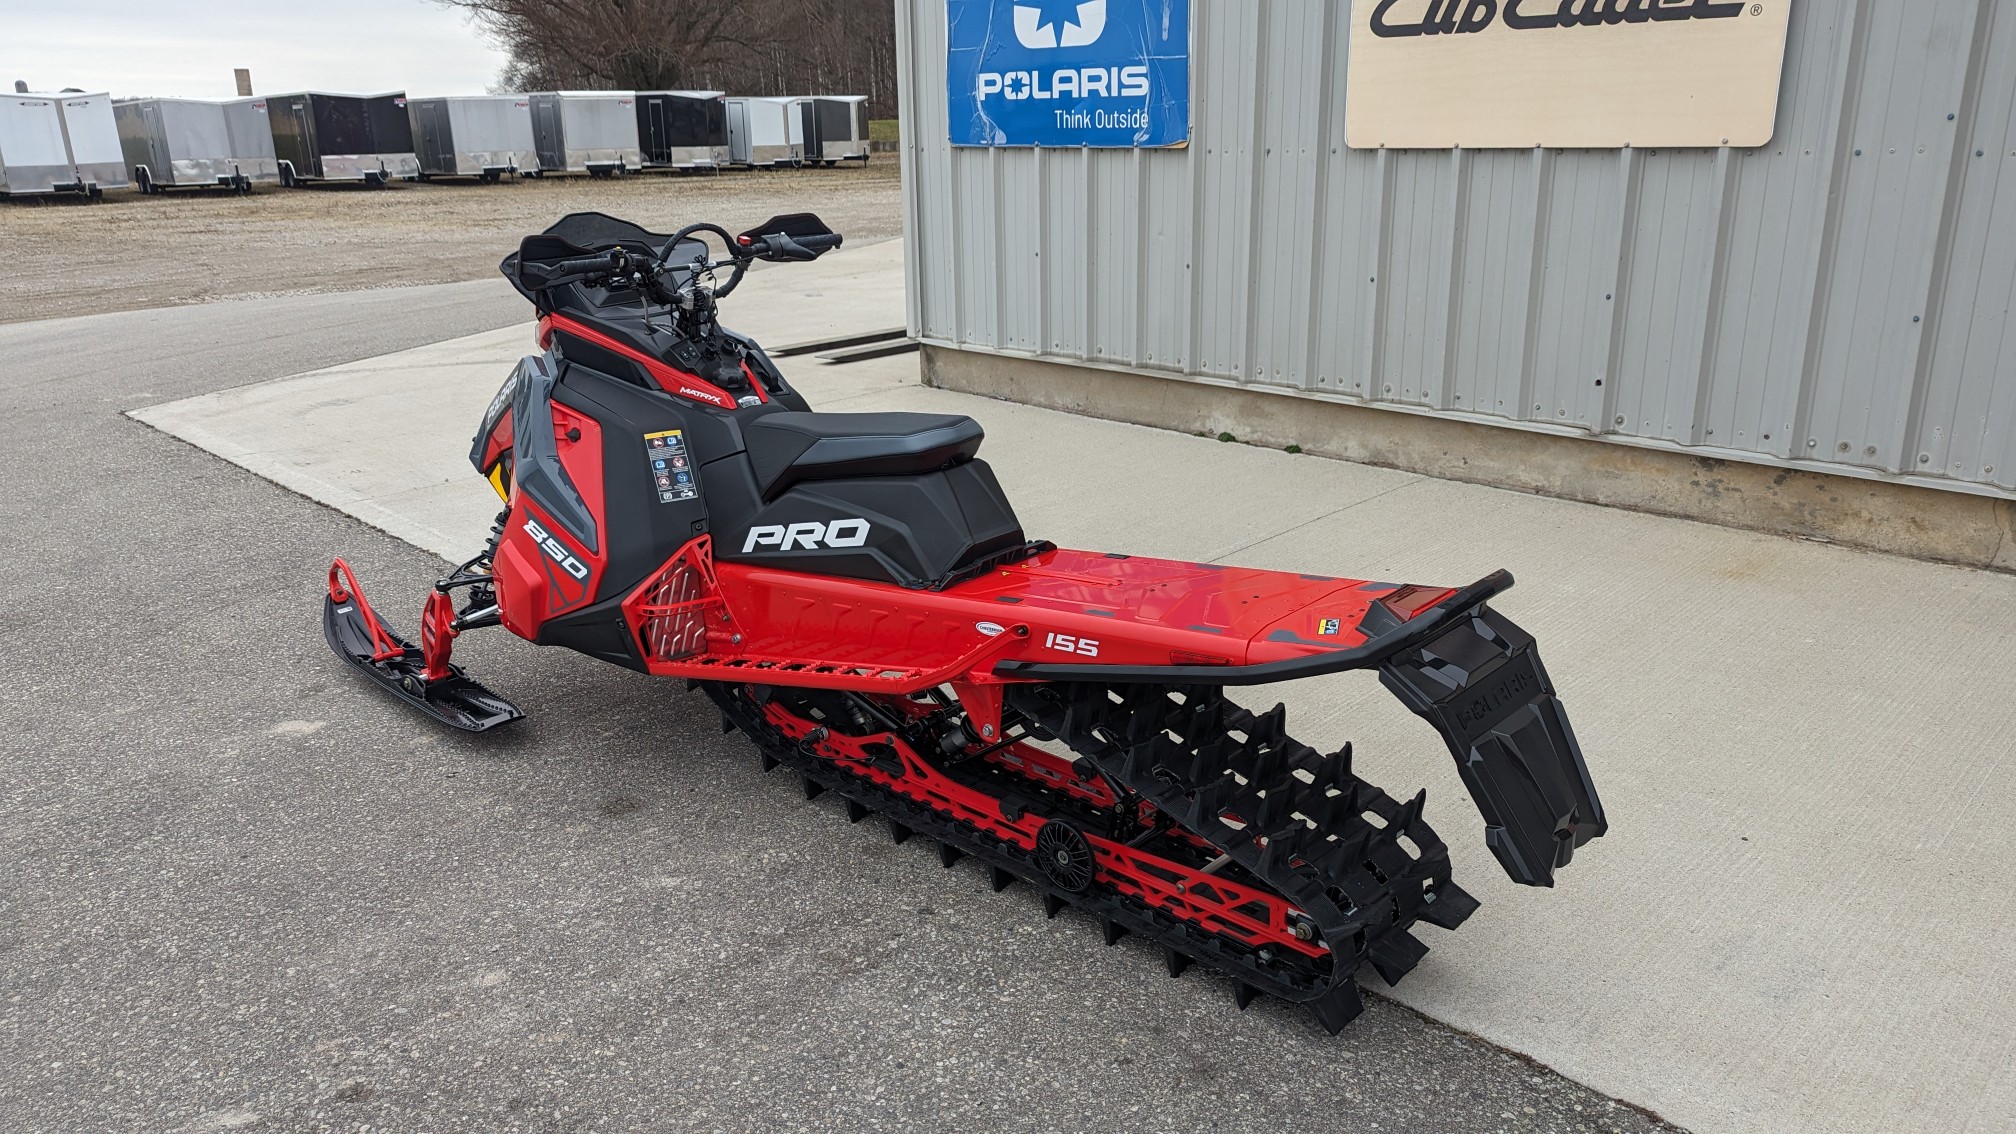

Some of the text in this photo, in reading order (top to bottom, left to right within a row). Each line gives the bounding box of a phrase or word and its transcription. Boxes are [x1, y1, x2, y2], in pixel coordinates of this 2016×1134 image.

[977, 66, 1150, 100] POLARIS
[1054, 109, 1149, 129] Think Outside
[679, 386, 721, 405] MATRYX
[522, 519, 588, 579] 850
[741, 518, 871, 553] PRO
[1045, 632, 1100, 657] 155
